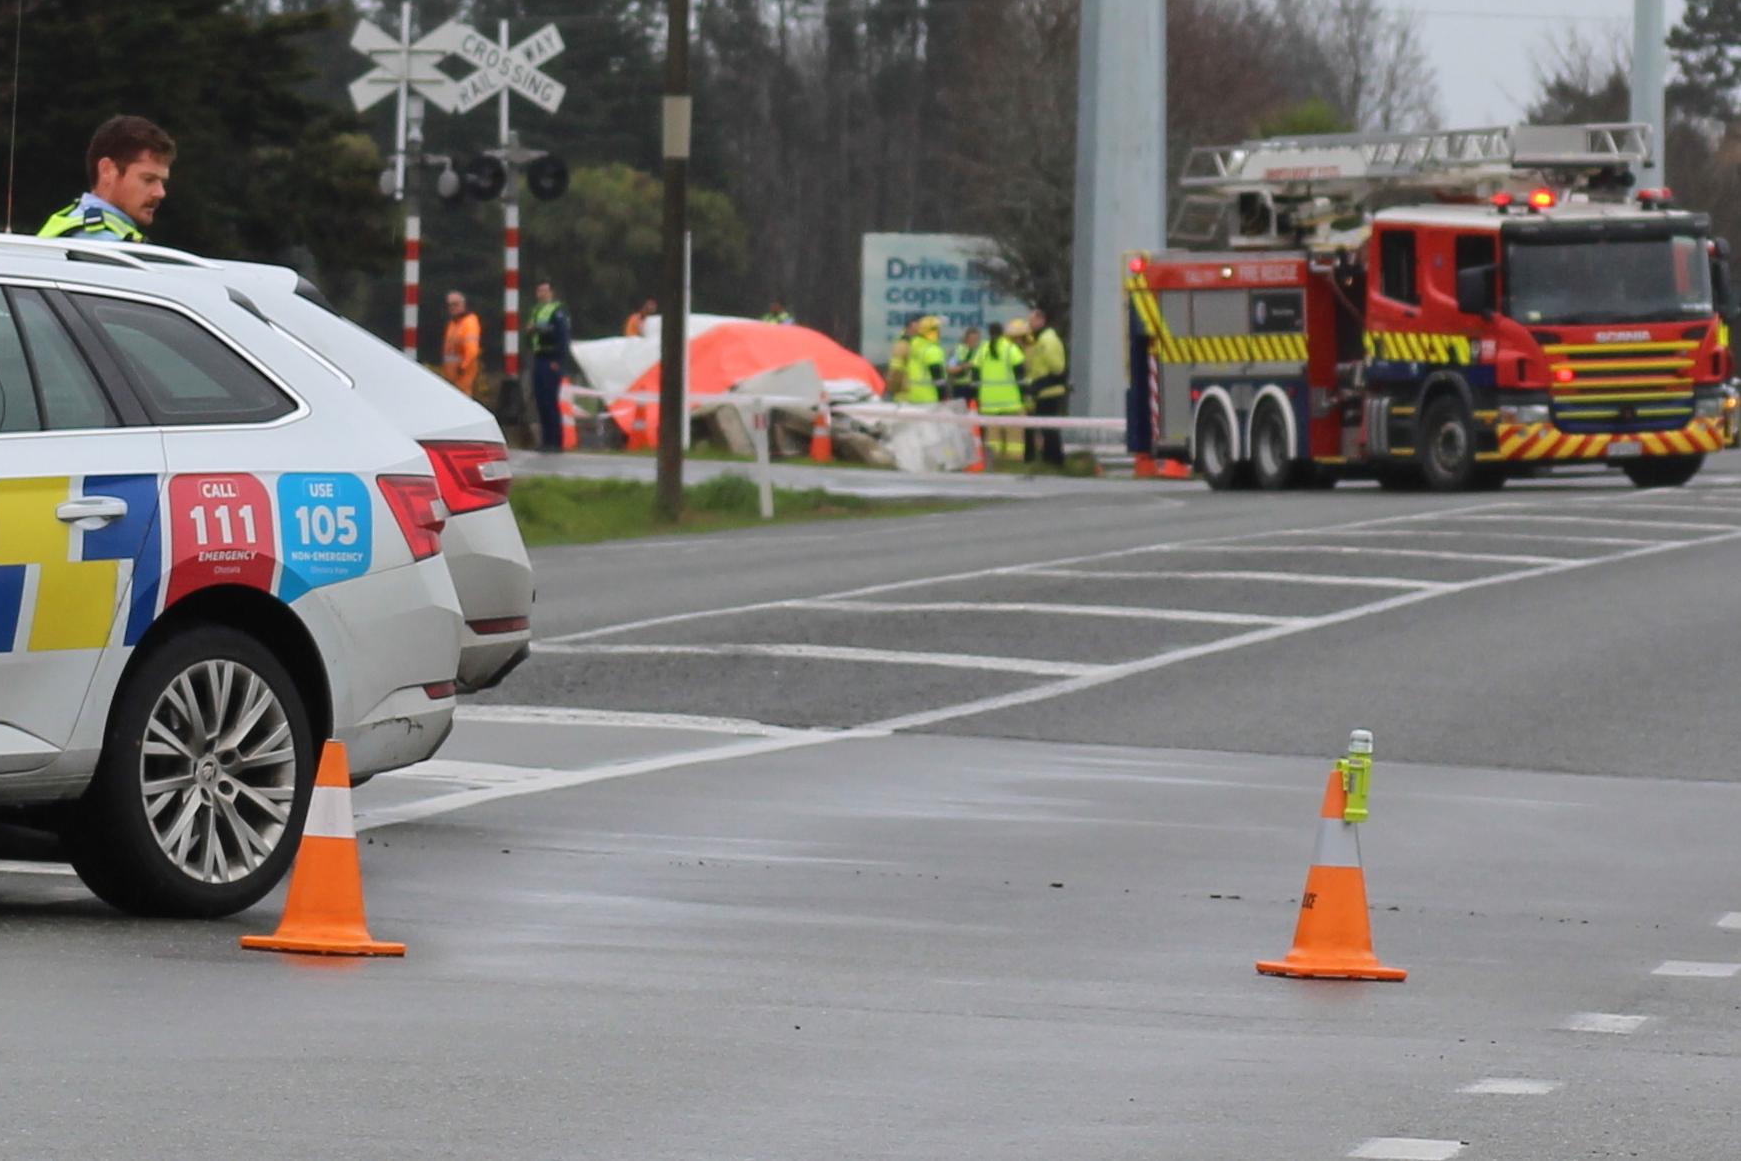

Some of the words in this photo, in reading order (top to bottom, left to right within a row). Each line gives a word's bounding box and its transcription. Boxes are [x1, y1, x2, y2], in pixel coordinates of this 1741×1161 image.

[458, 72, 498, 105] RAIL
[522, 31, 555, 61] WAY
[462, 34, 554, 102] CROSSING
[887, 257, 961, 280] Drive
[886, 288, 953, 307] cops
[202, 483, 237, 498] CALL
[309, 483, 334, 498] USE
[189, 504, 257, 545] 111
[295, 505, 358, 546] 105
[198, 550, 258, 563] EMERGENCY
[291, 551, 364, 563] NON-EMERGENCY
